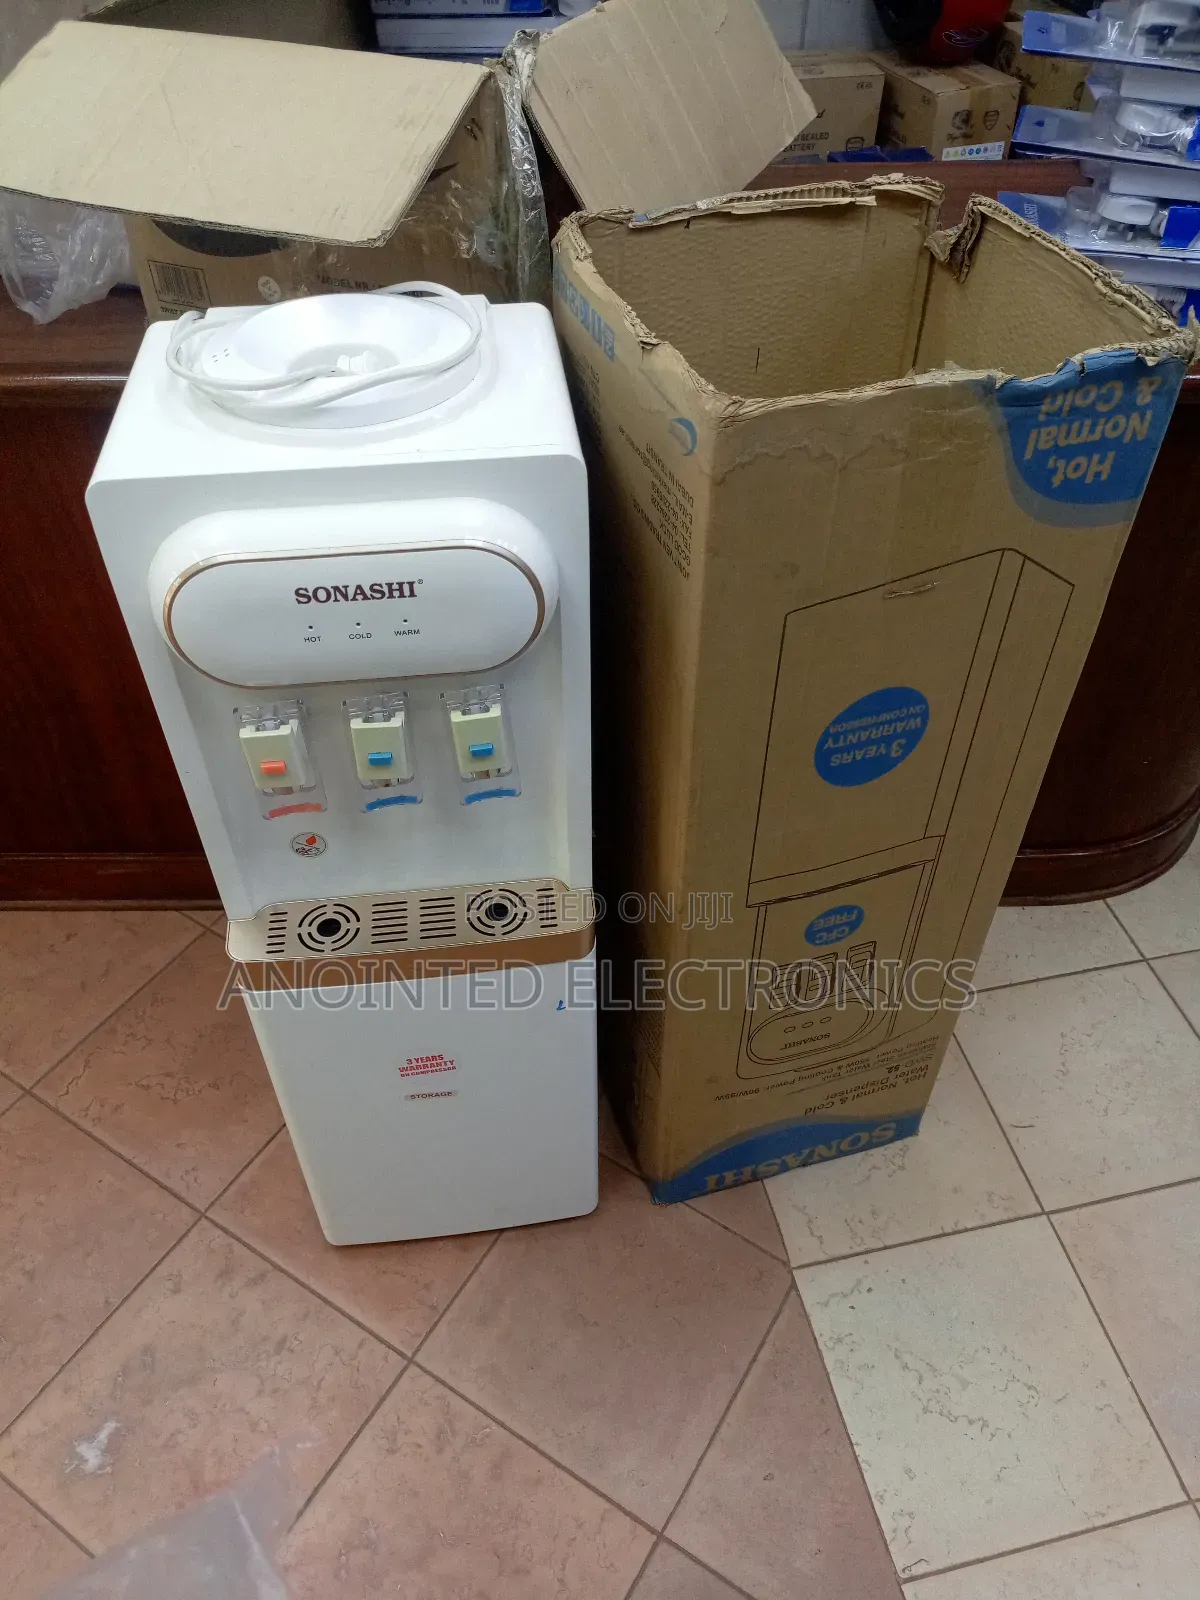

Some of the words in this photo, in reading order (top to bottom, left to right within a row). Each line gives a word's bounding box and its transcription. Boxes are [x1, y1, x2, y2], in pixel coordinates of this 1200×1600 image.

[1038, 380, 1124, 422] Cold
[1135, 376, 1162, 406] &
[1024, 410, 1153, 461] Normal
[1047, 451, 1116, 488] Hot,
[660, 521, 674, 544] LUCK
[674, 540, 691, 566] GOOD
[304, 635, 322, 643] HOT
[348, 632, 373, 640] COLD
[394, 629, 421, 637] WARM
[822, 716, 922, 751] WARRANTY
[829, 743, 888, 767] YEARS
[889, 738, 907, 758] 3
[813, 909, 859, 930] FREE
[814, 924, 850, 945] CFC
[398, 1060, 455, 1073] WARRANTY
[413, 1054, 444, 1064] YEARS
[845, 1064, 871, 1074] Water
[411, 1066, 457, 1077] COMPRESSOR
[797, 1067, 834, 1082] Cooling
[820, 1071, 842, 1081] Tank
[894, 1064, 929, 1080] Water
[410, 1091, 453, 1100] STORAGE
[825, 1077, 890, 1101] Dispenser
[851, 1081, 898, 1101] Normal
[804, 1101, 835, 1116] Cold
[839, 1096, 849, 1105] &
[703, 1121, 897, 1192] SONASHI
